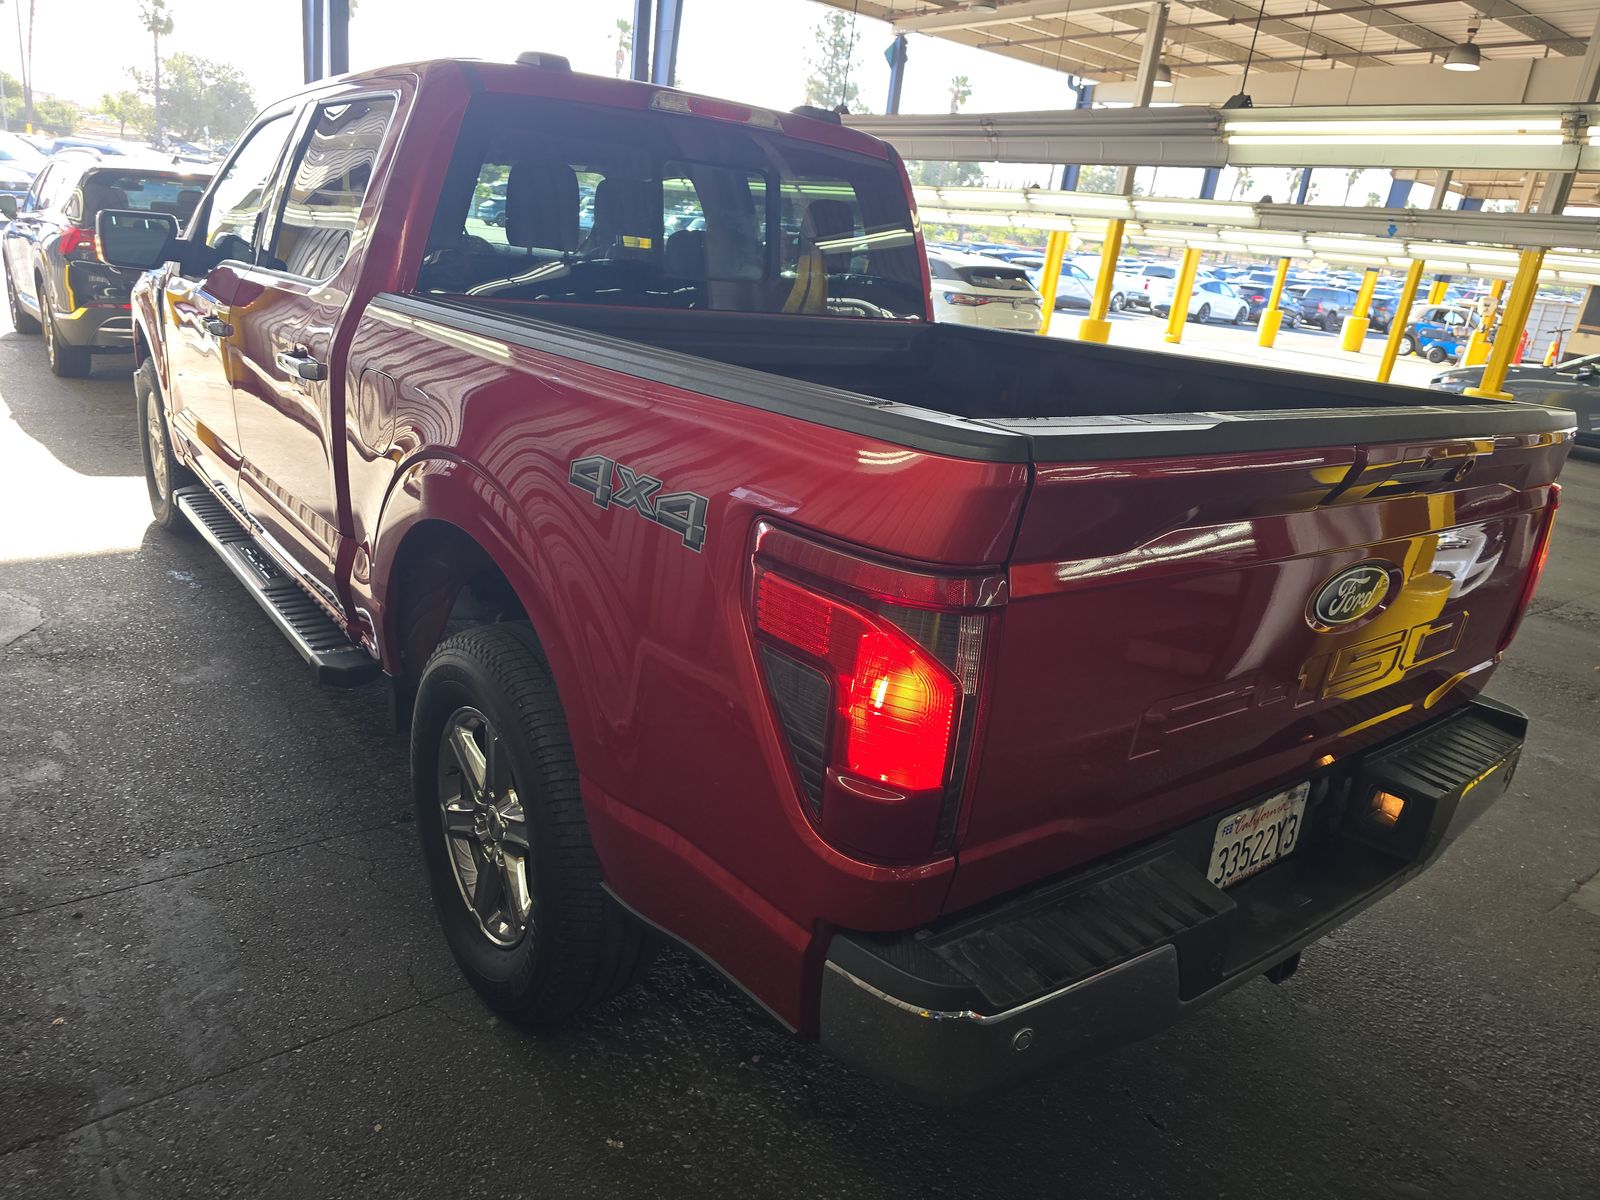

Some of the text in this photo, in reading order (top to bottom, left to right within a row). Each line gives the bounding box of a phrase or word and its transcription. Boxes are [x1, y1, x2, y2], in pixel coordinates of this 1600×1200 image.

[1328, 575, 1377, 616] Ford
[1234, 801, 1292, 834] California
[1214, 814, 1298, 884] 33522Y3
